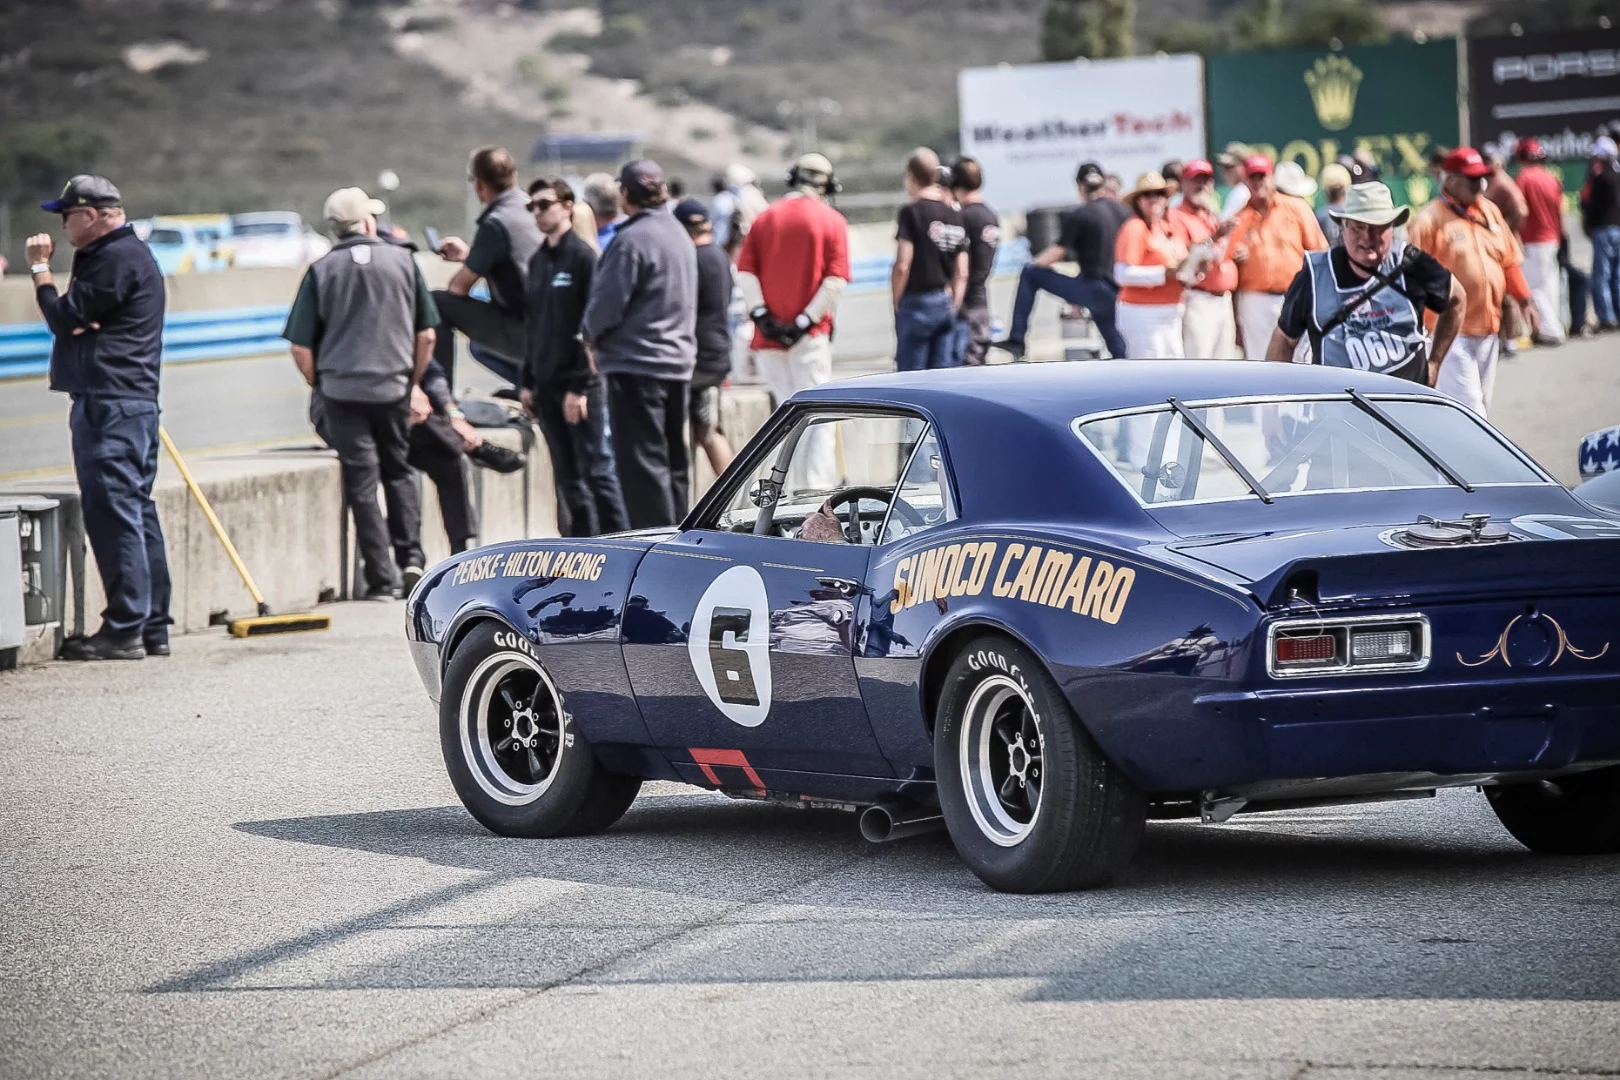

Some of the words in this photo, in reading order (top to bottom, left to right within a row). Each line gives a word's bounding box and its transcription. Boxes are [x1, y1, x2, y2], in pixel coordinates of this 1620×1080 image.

[1493, 49, 1620, 83] PORS
[452, 550, 554, 587] PENSKE-HILTON
[549, 551, 607, 581] RACING
[890, 542, 997, 615] SUNOCO
[992, 543, 1136, 625] CAMARO
[708, 606, 761, 707] 6
